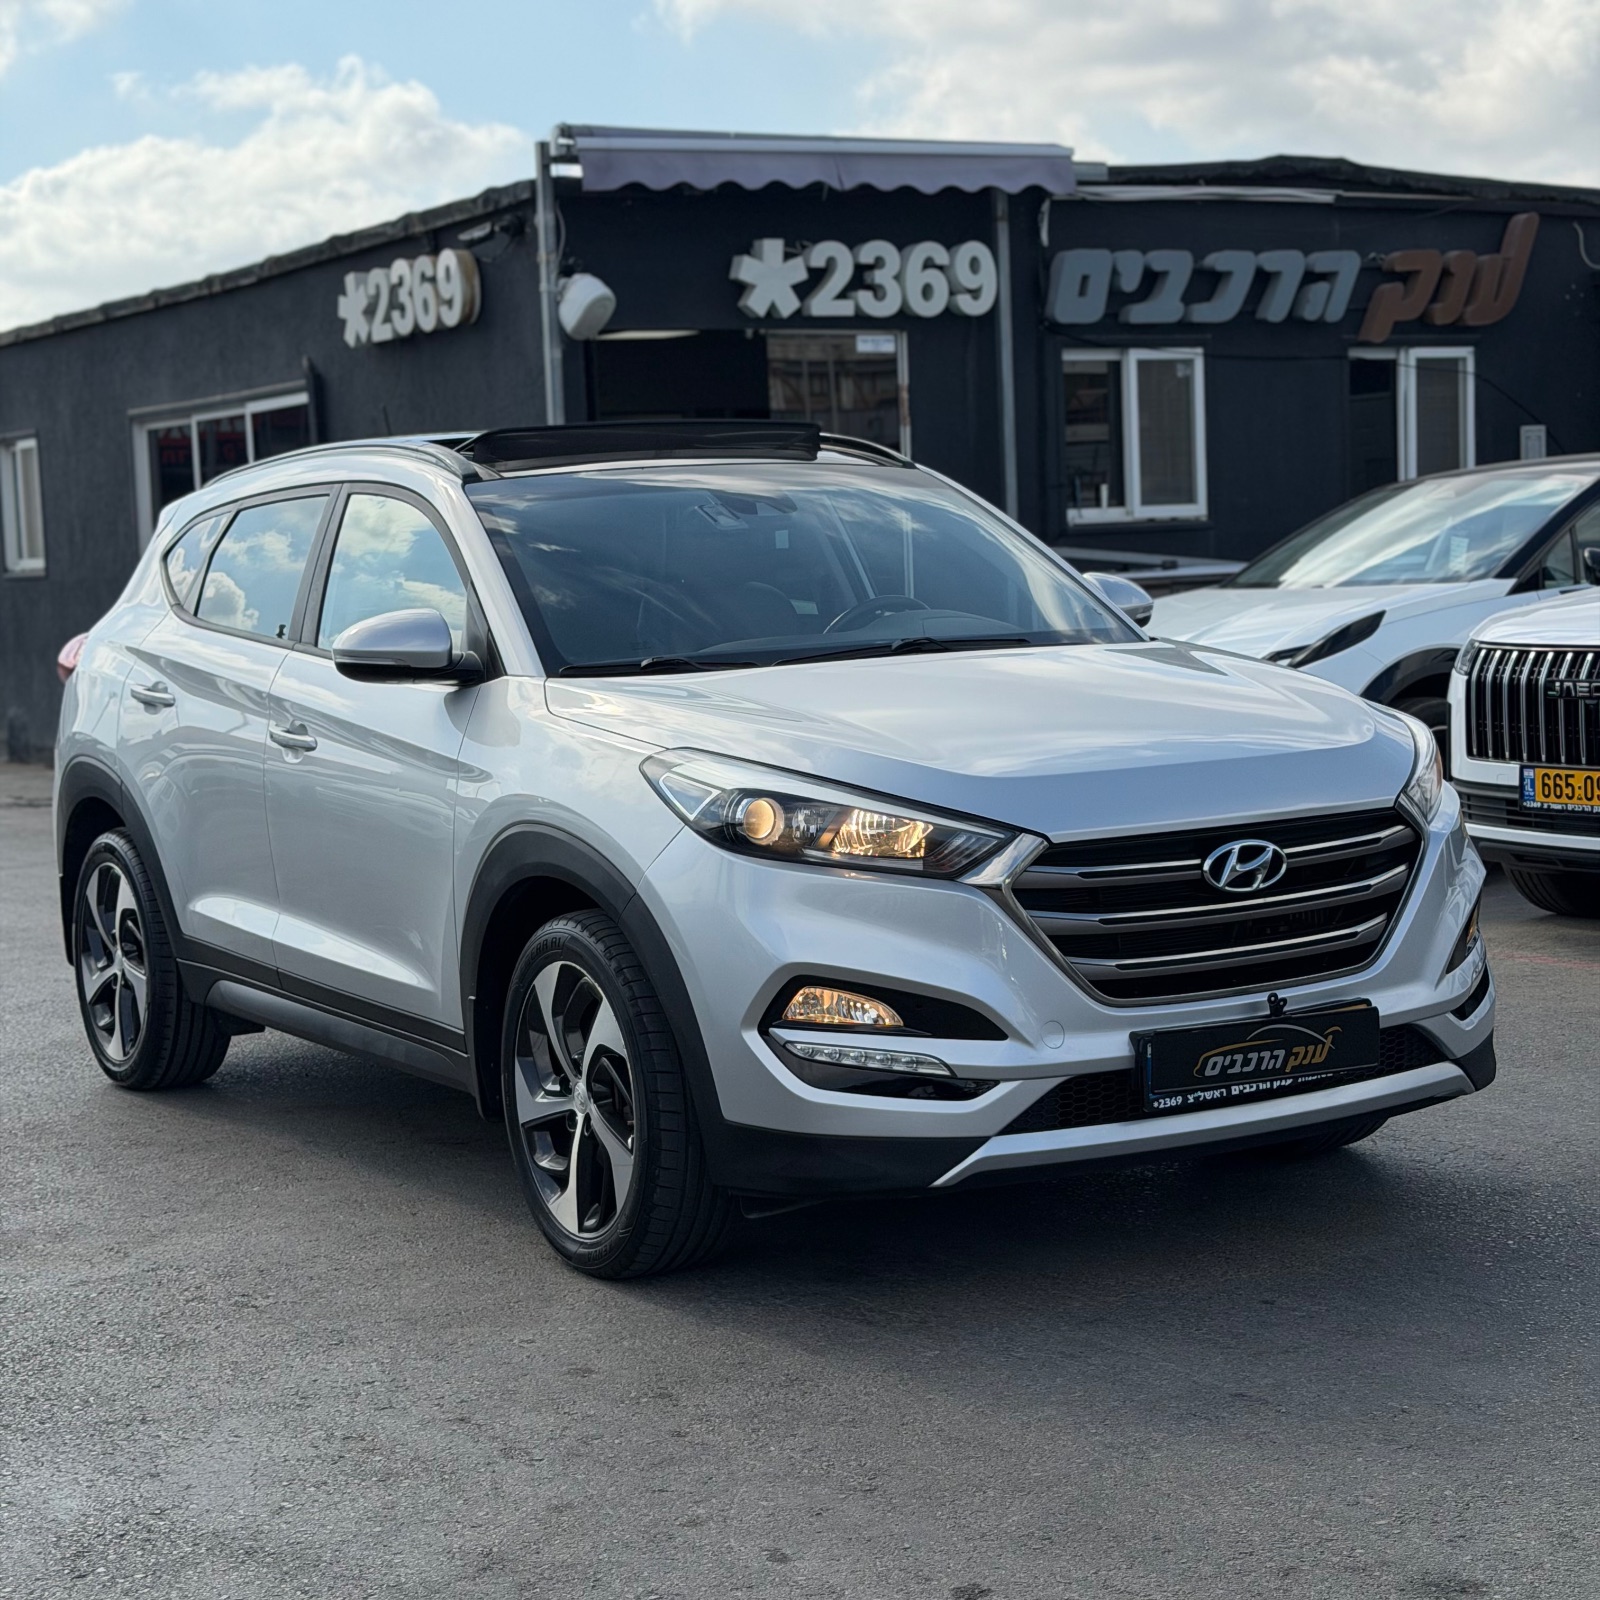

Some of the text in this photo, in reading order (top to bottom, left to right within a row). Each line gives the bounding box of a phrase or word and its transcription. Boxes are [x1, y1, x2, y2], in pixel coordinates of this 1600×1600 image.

[1046, 211, 1540, 343] ענק הרכבים
[1204, 1034, 1334, 1077] ענק הרכבים
